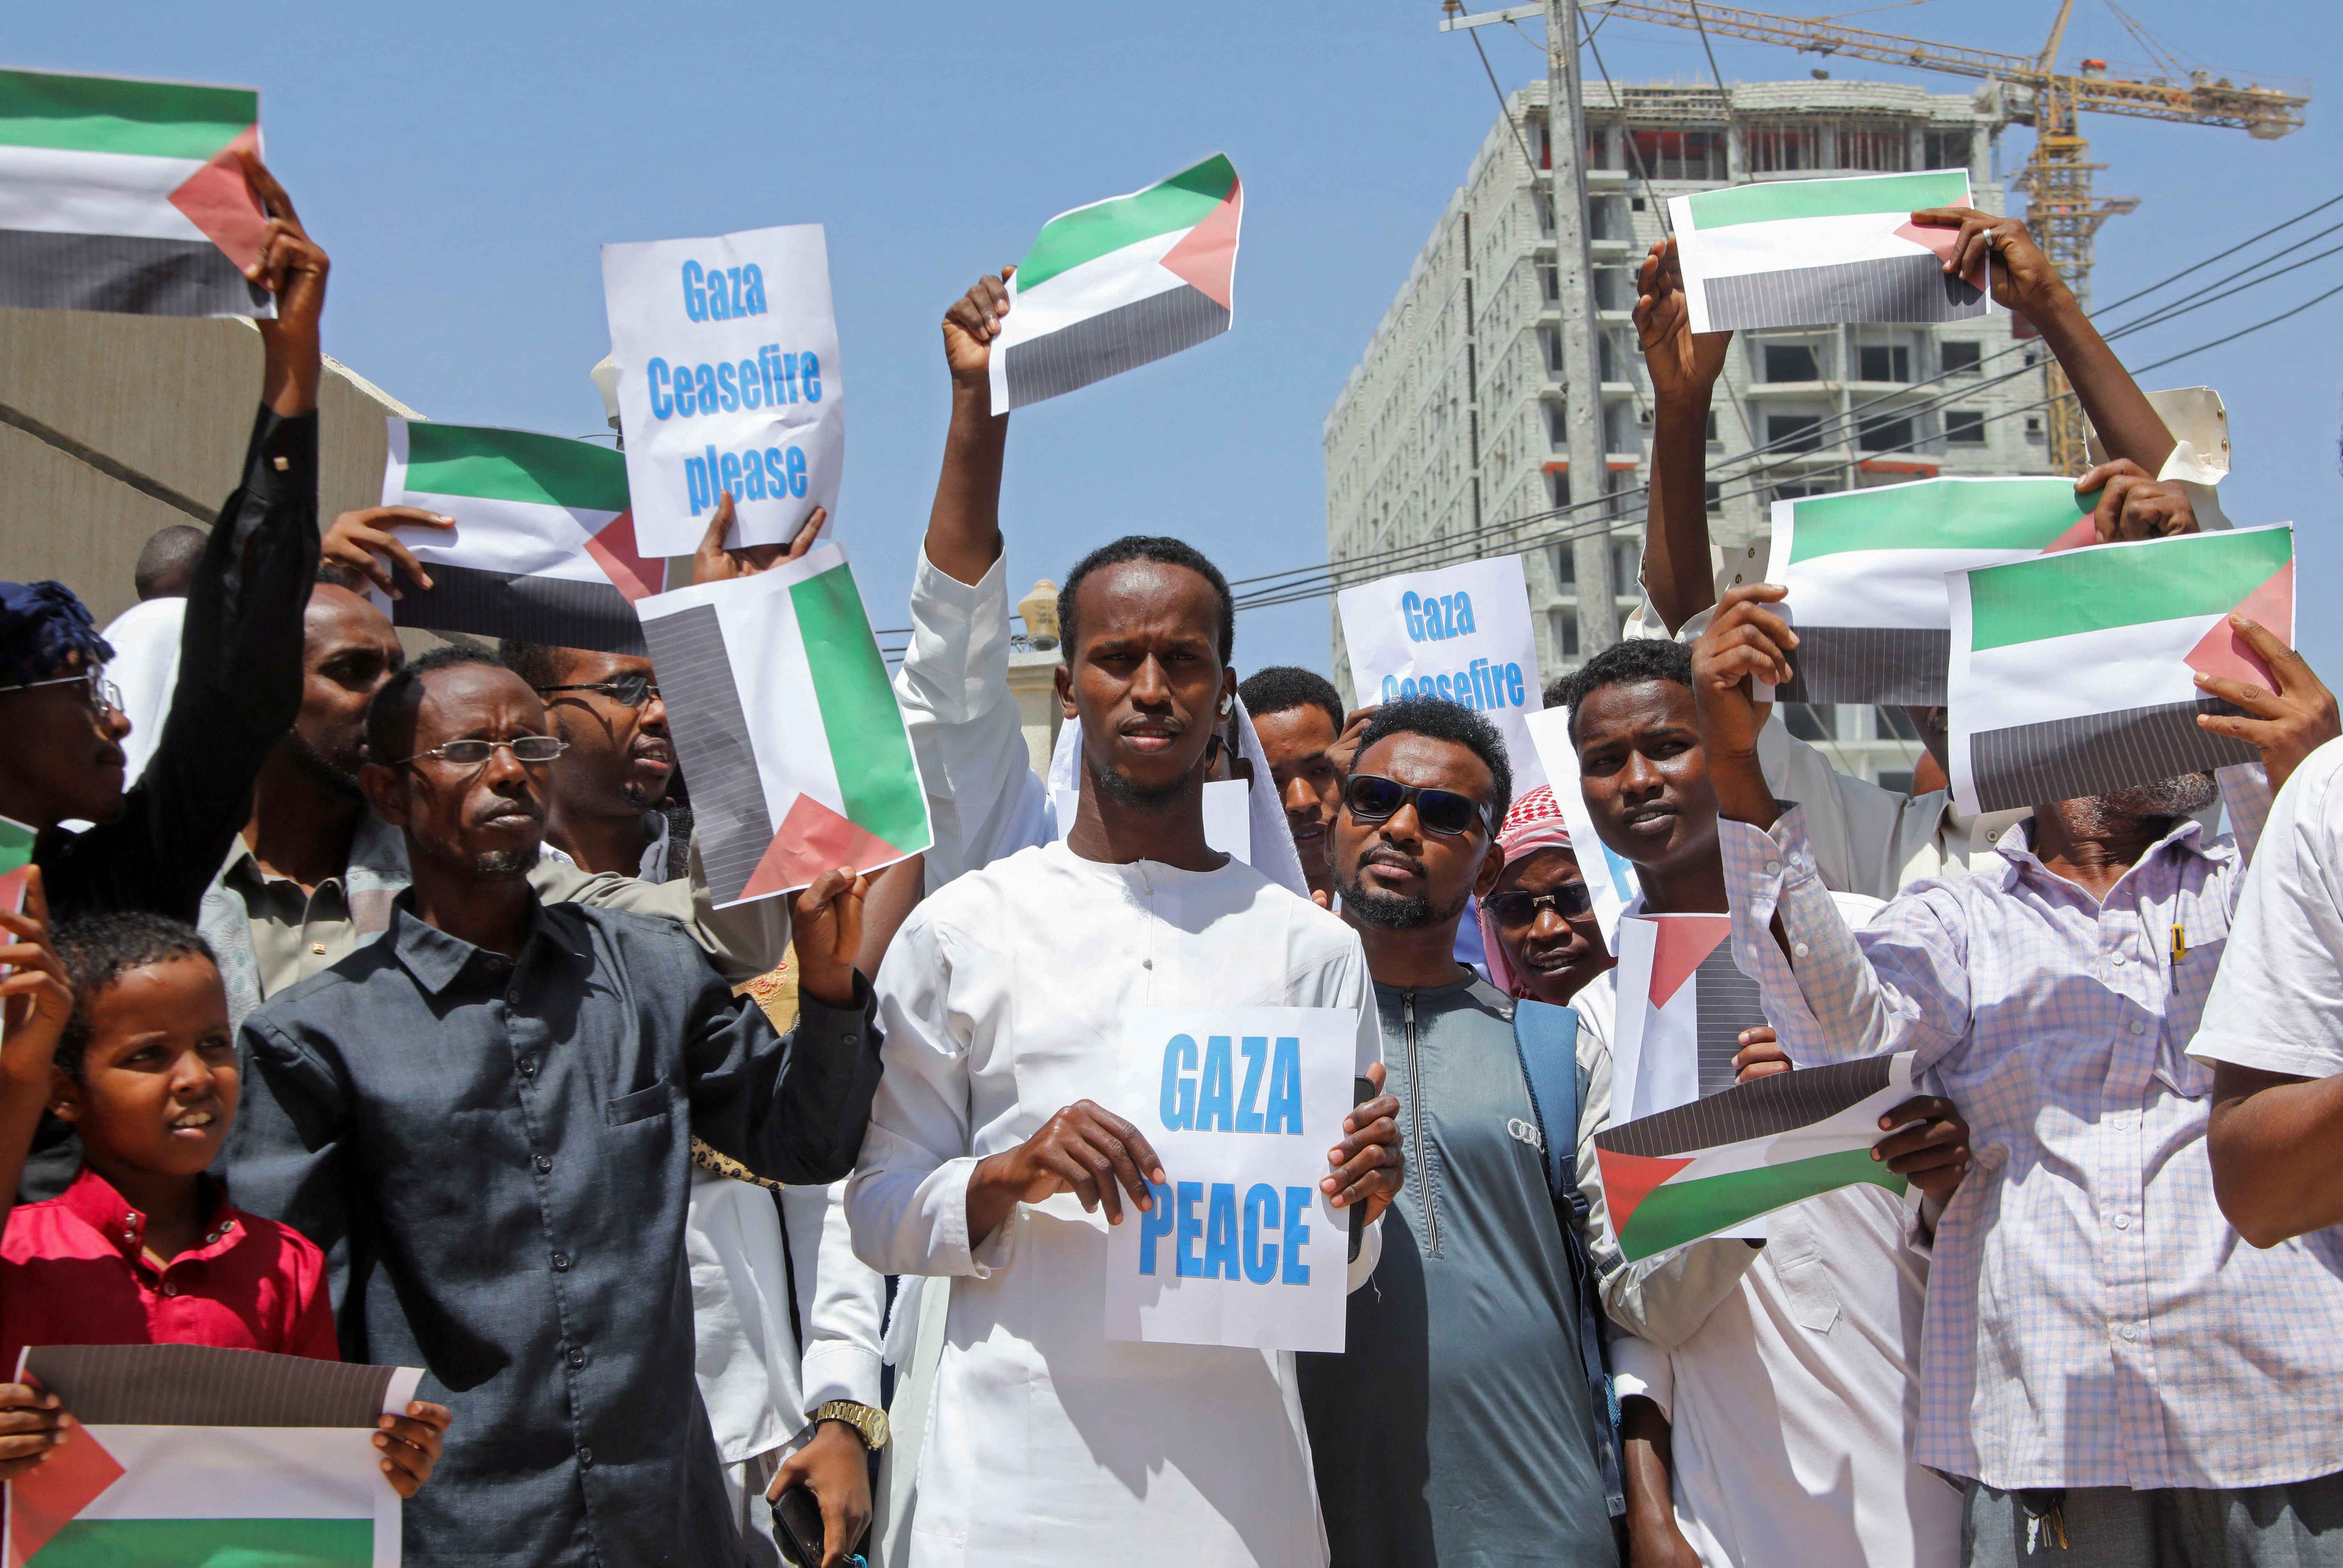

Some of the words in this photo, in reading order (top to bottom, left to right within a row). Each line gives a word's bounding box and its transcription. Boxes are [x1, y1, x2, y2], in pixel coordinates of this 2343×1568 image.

[682, 259, 767, 323] Gaza
[647, 343, 822, 421] Ceasefire
[684, 444, 808, 516] please
[1402, 591, 1476, 643] Gaza
[1159, 1033, 1303, 1135] GAZA
[1139, 1179, 1312, 1285] PEACE
